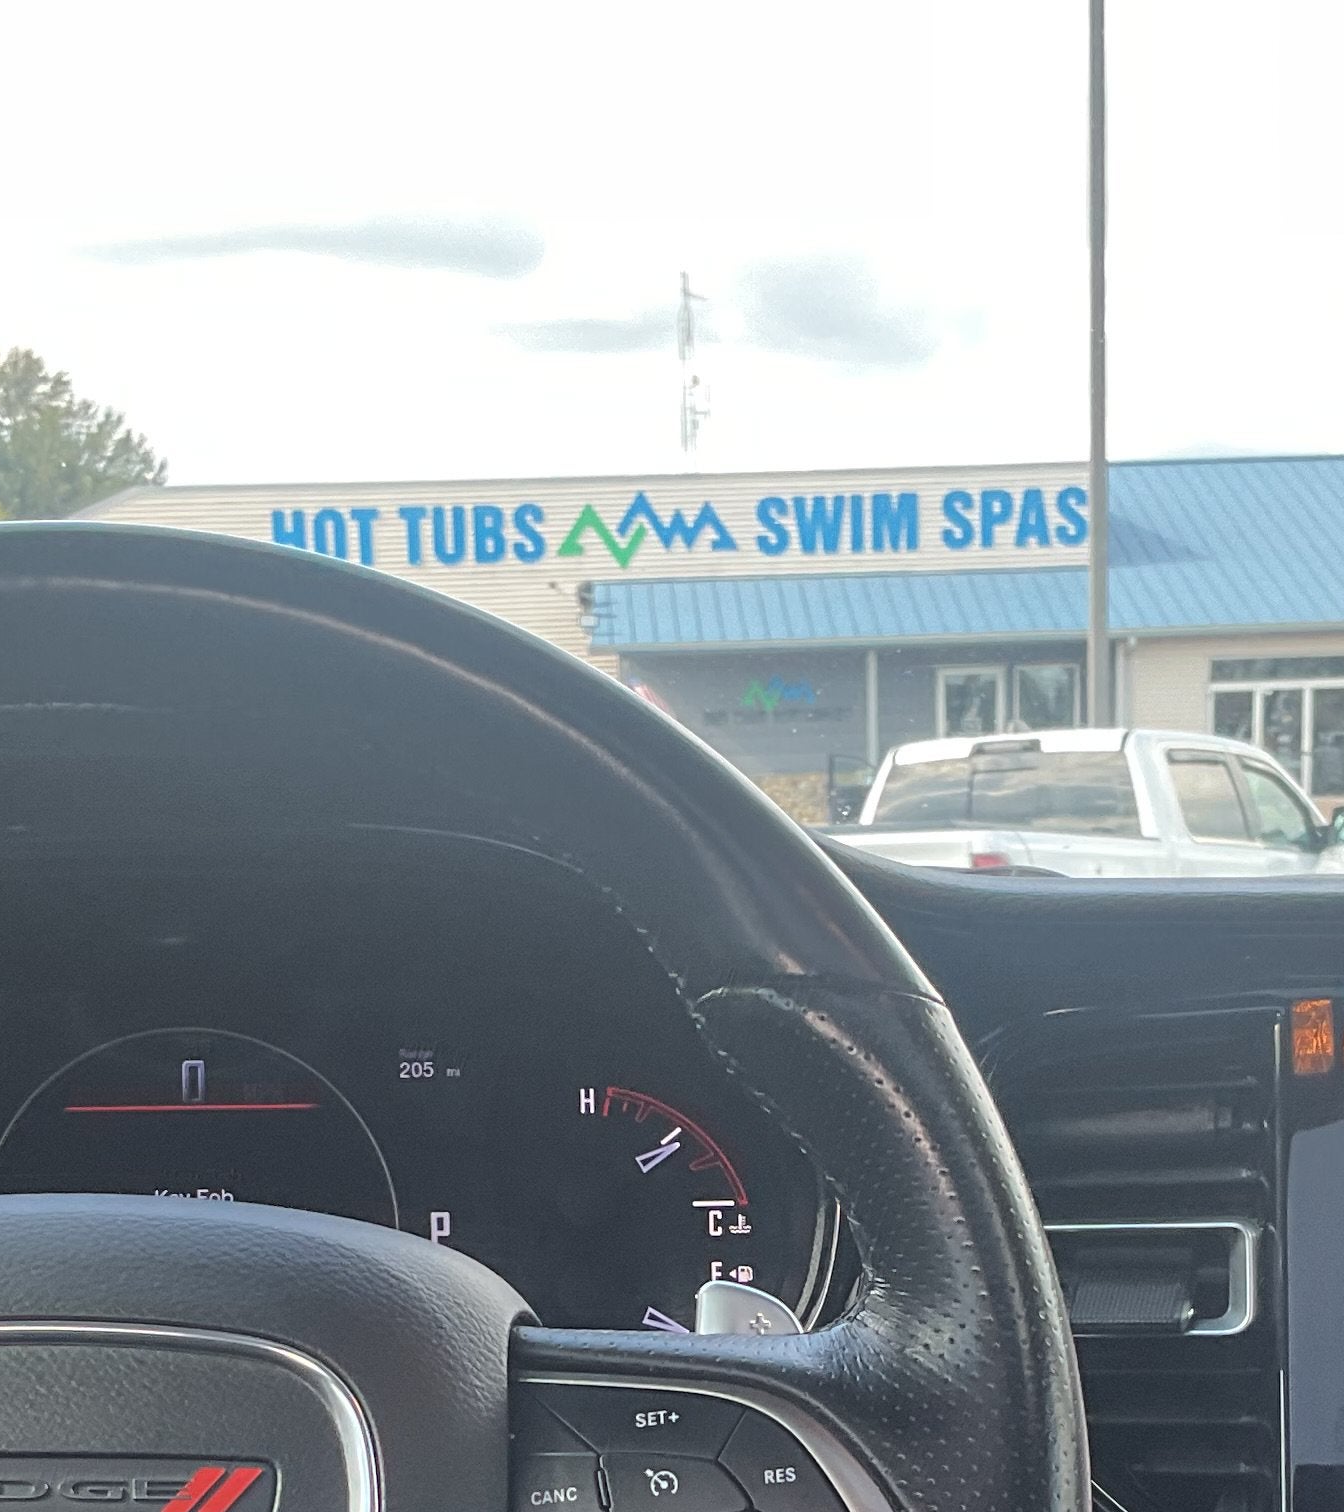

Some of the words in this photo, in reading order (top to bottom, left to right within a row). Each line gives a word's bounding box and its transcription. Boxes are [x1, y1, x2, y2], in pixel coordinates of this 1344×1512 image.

[271, 507, 380, 566] HOT
[398, 503, 547, 567] TUBS
[756, 492, 920, 557] SWIM
[940, 486, 1090, 549] SPAS
[399, 1061, 434, 1079] 205
[579, 1088, 596, 1114] H
[430, 1210, 451, 1242] P
[708, 1210, 723, 1236] C
[635, 1411, 679, 1428] SET+
[764, 1467, 797, 1485] RES
[530, 1487, 578, 1506] CANC
